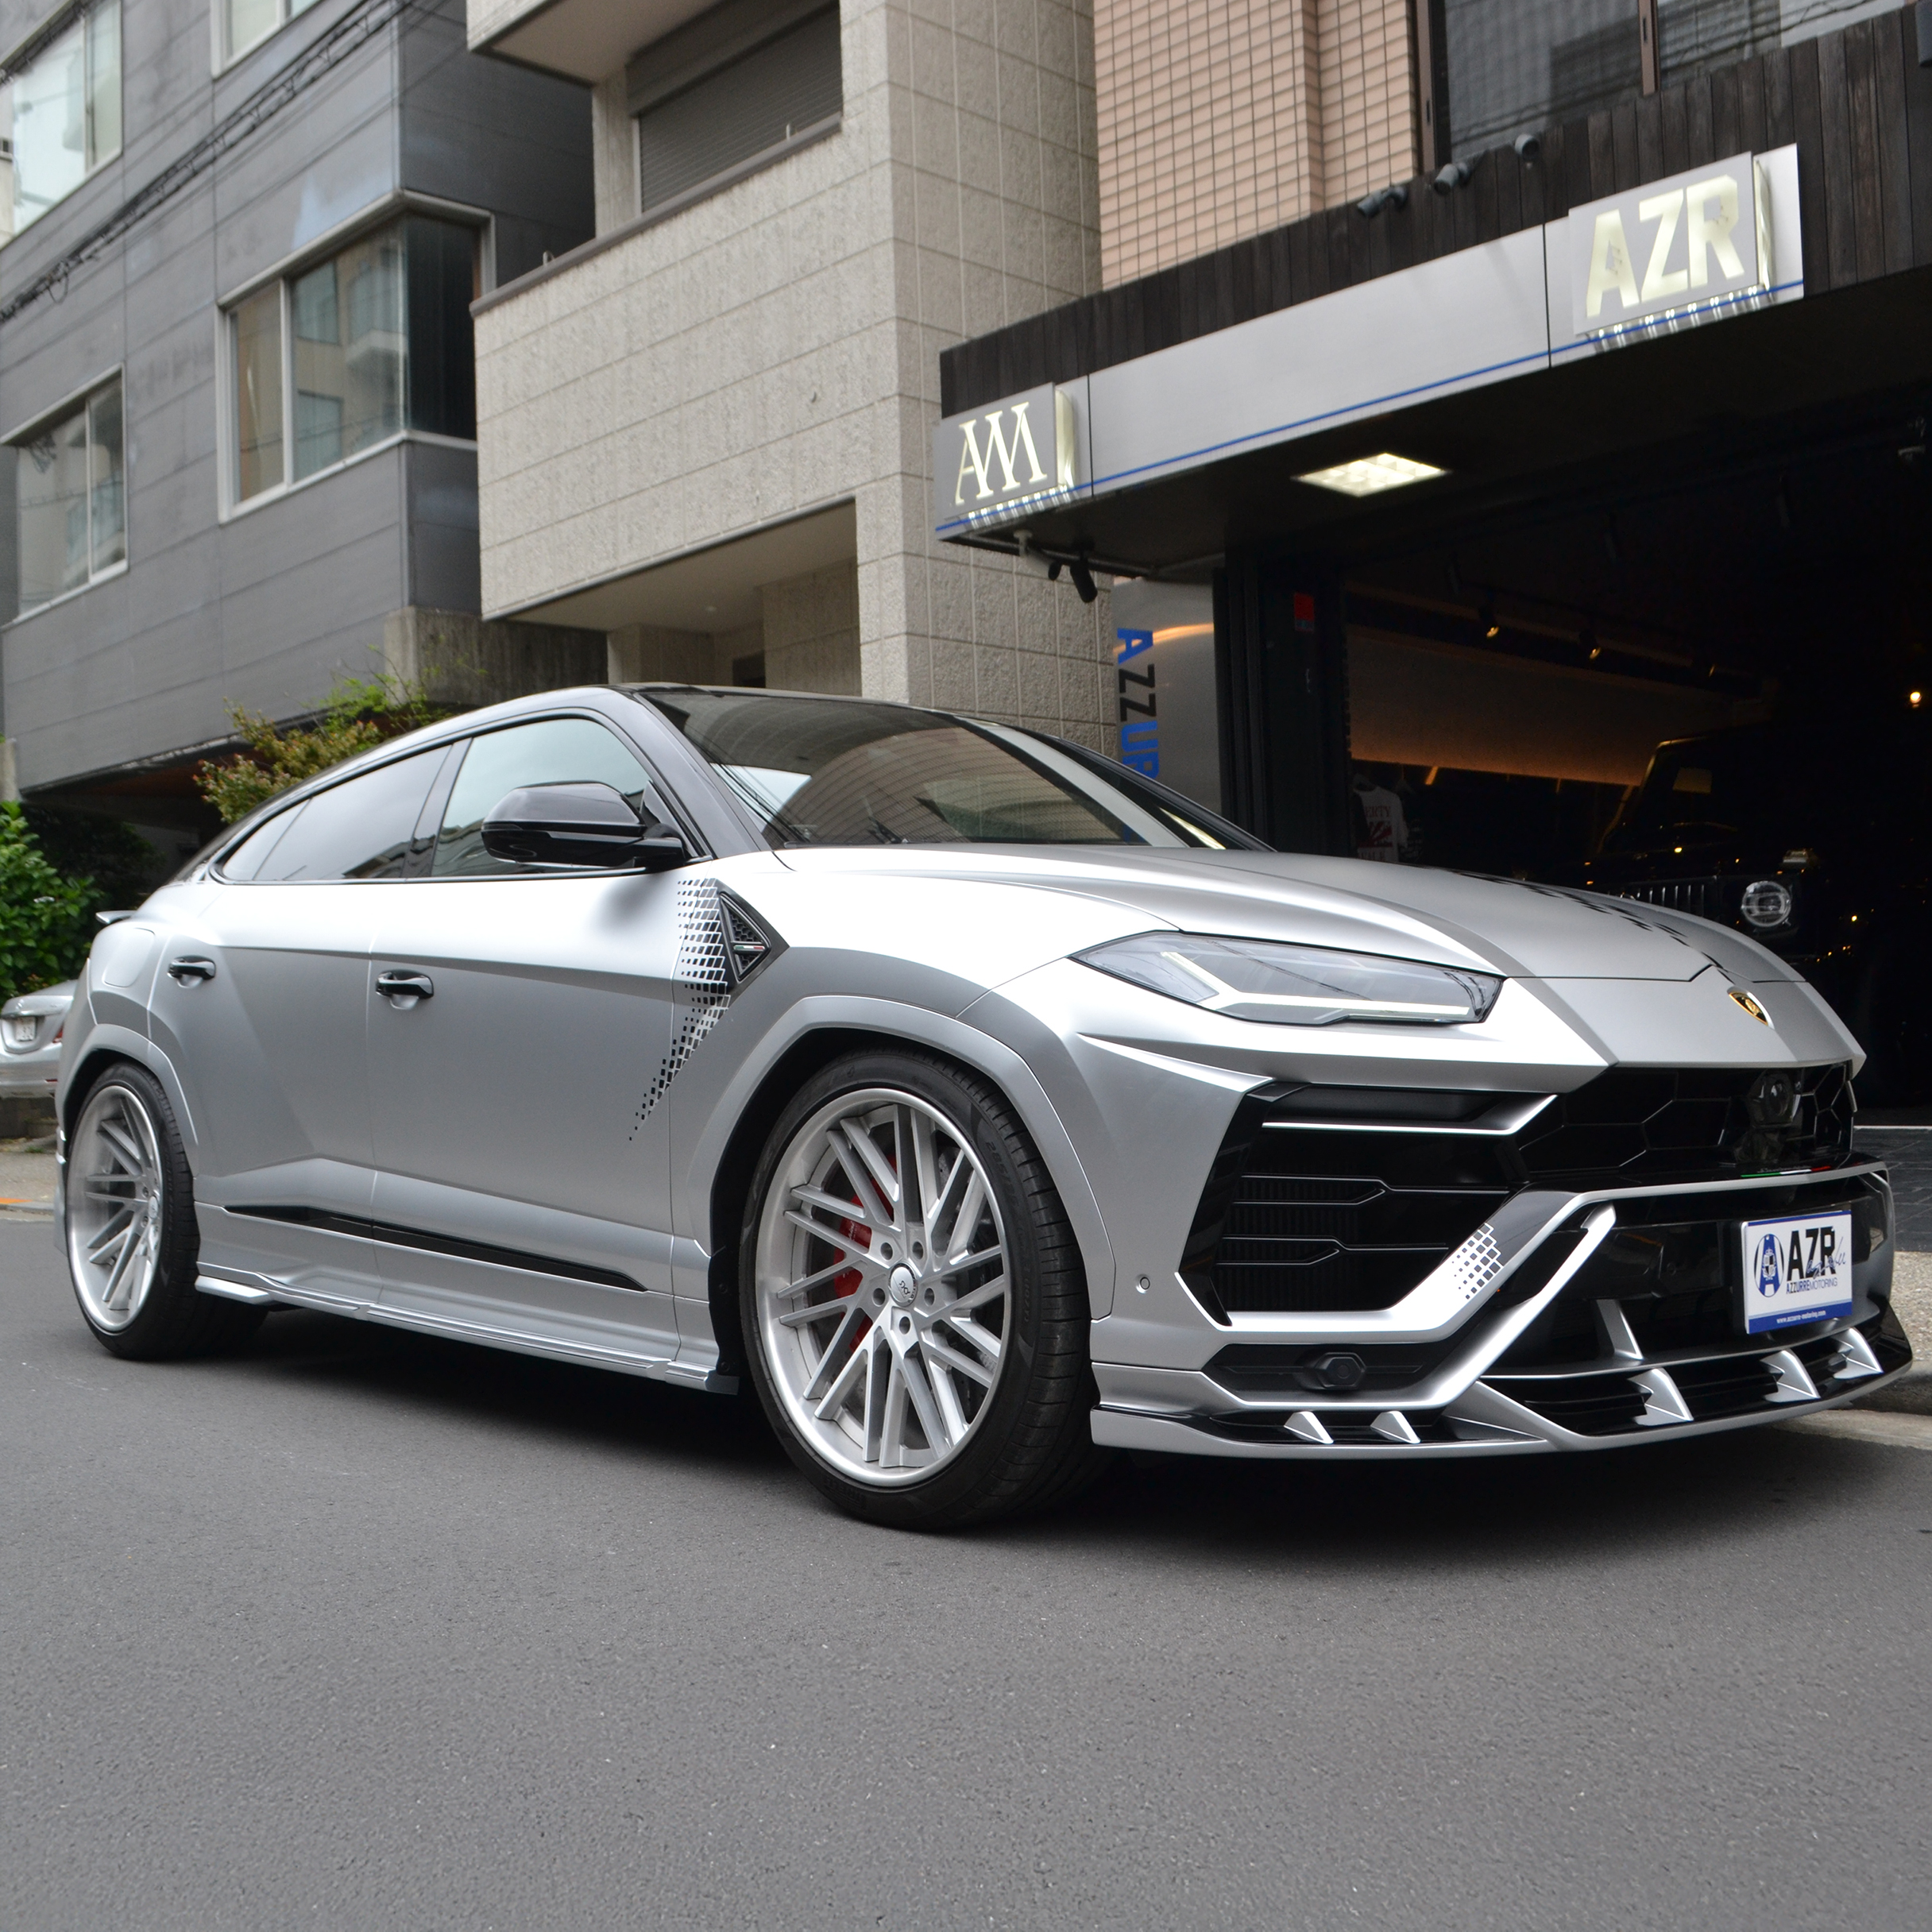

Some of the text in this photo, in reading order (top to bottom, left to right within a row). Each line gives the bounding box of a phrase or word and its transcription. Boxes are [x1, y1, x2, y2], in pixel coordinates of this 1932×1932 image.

[1586, 174, 1745, 319] AZR
[1117, 628, 1160, 779] AZZUR
[1787, 1226, 1837, 1281] AZR
